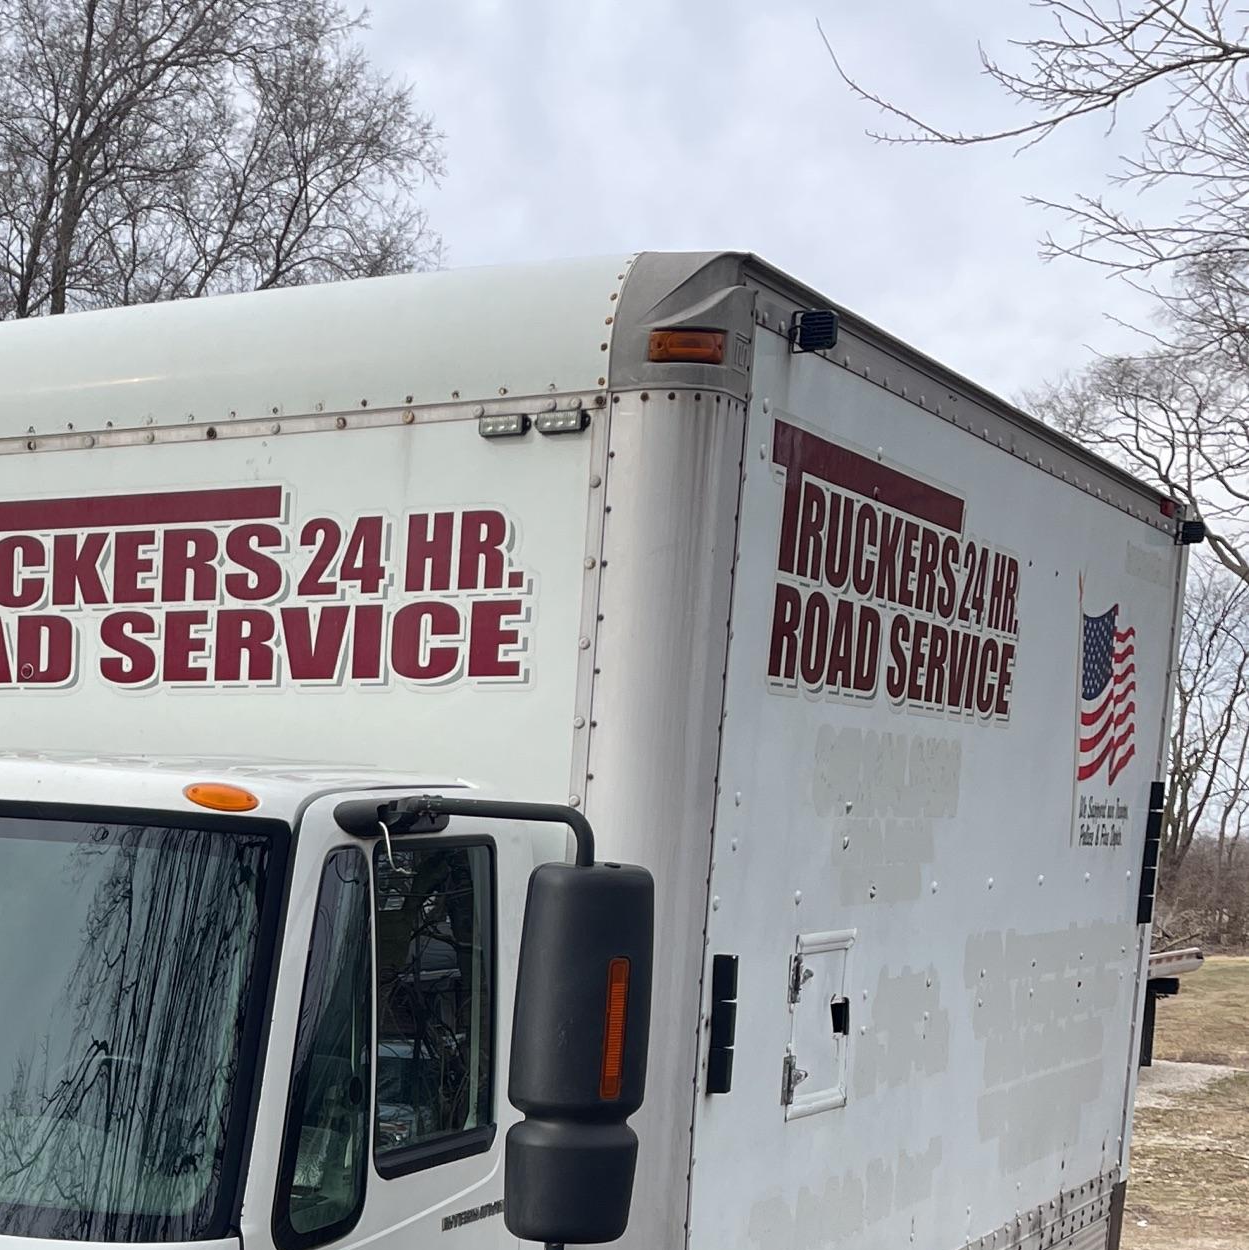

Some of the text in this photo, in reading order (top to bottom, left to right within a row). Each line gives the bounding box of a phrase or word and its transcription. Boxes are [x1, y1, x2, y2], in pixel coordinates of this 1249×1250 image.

[296, 514, 386, 597] 24
[403, 510, 524, 592] HR.
[772, 419, 1019, 635] TRUCKERS 24 HR.
[99, 599, 524, 682] SERVICE
[768, 582, 1016, 715] ROAD SERVICE
